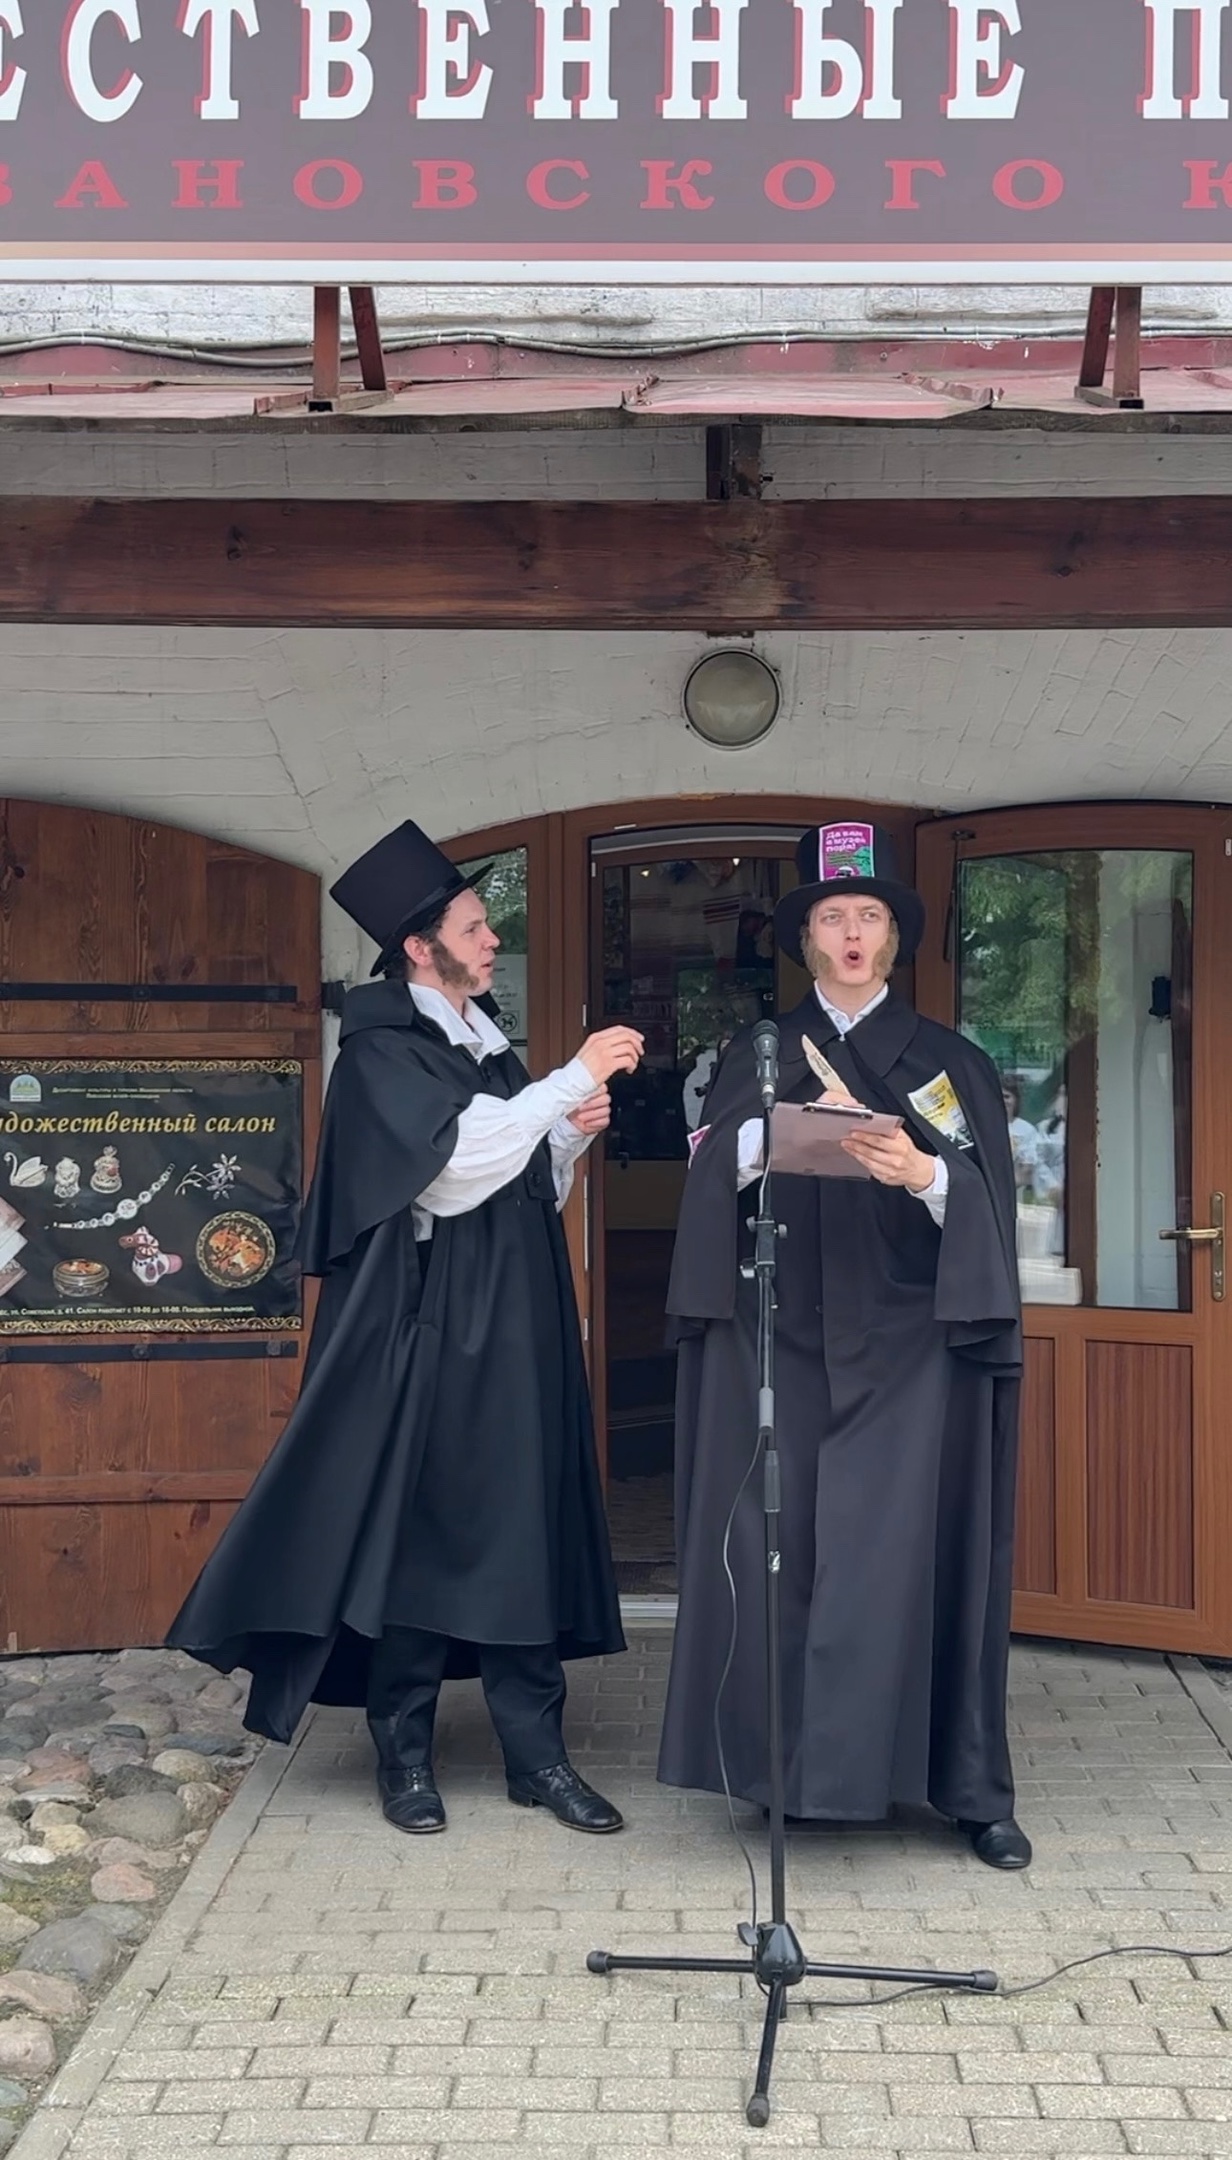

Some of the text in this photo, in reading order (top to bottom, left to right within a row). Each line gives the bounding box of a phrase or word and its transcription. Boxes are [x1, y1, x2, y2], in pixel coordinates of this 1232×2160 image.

[1137, 0, 1230, 119] П
[0, 158, 1064, 210] АНОВСКОГО
[205, 1116, 276, 1133] салон
